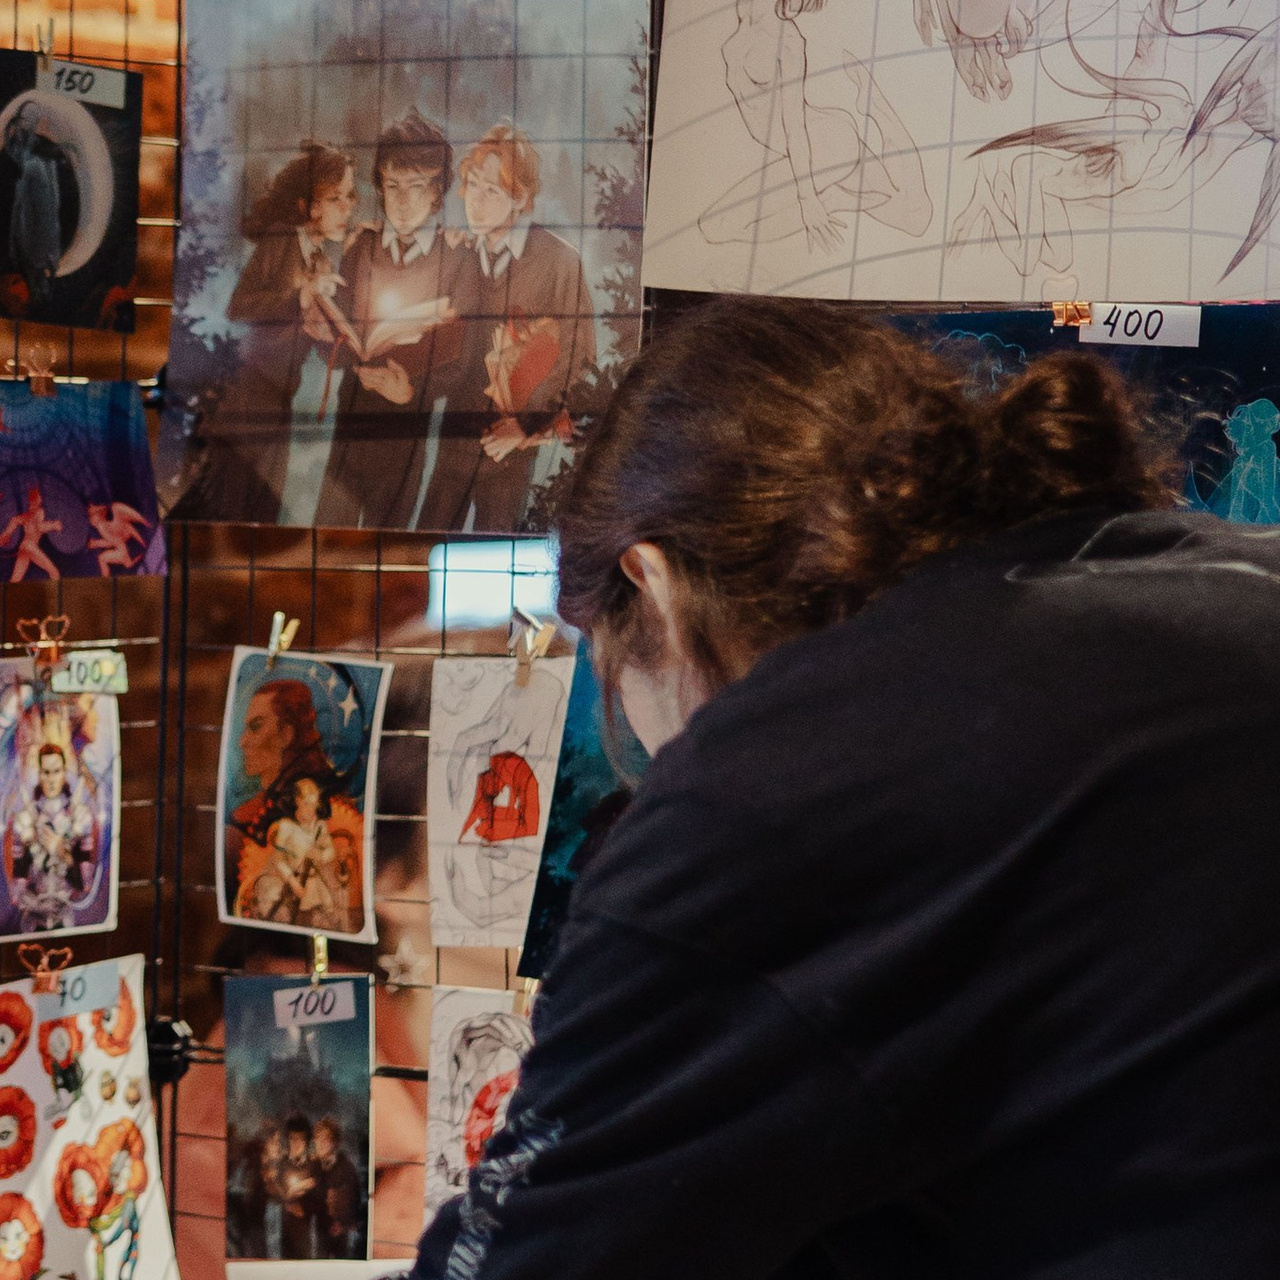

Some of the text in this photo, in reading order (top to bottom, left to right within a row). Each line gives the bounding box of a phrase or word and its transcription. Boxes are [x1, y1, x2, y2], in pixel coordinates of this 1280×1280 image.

[53, 66, 95, 94] 150
[1103, 304, 1164, 340] 400
[67, 660, 102, 685] 100
[58, 976, 87, 1007] 70
[288, 987, 336, 1019] 100
